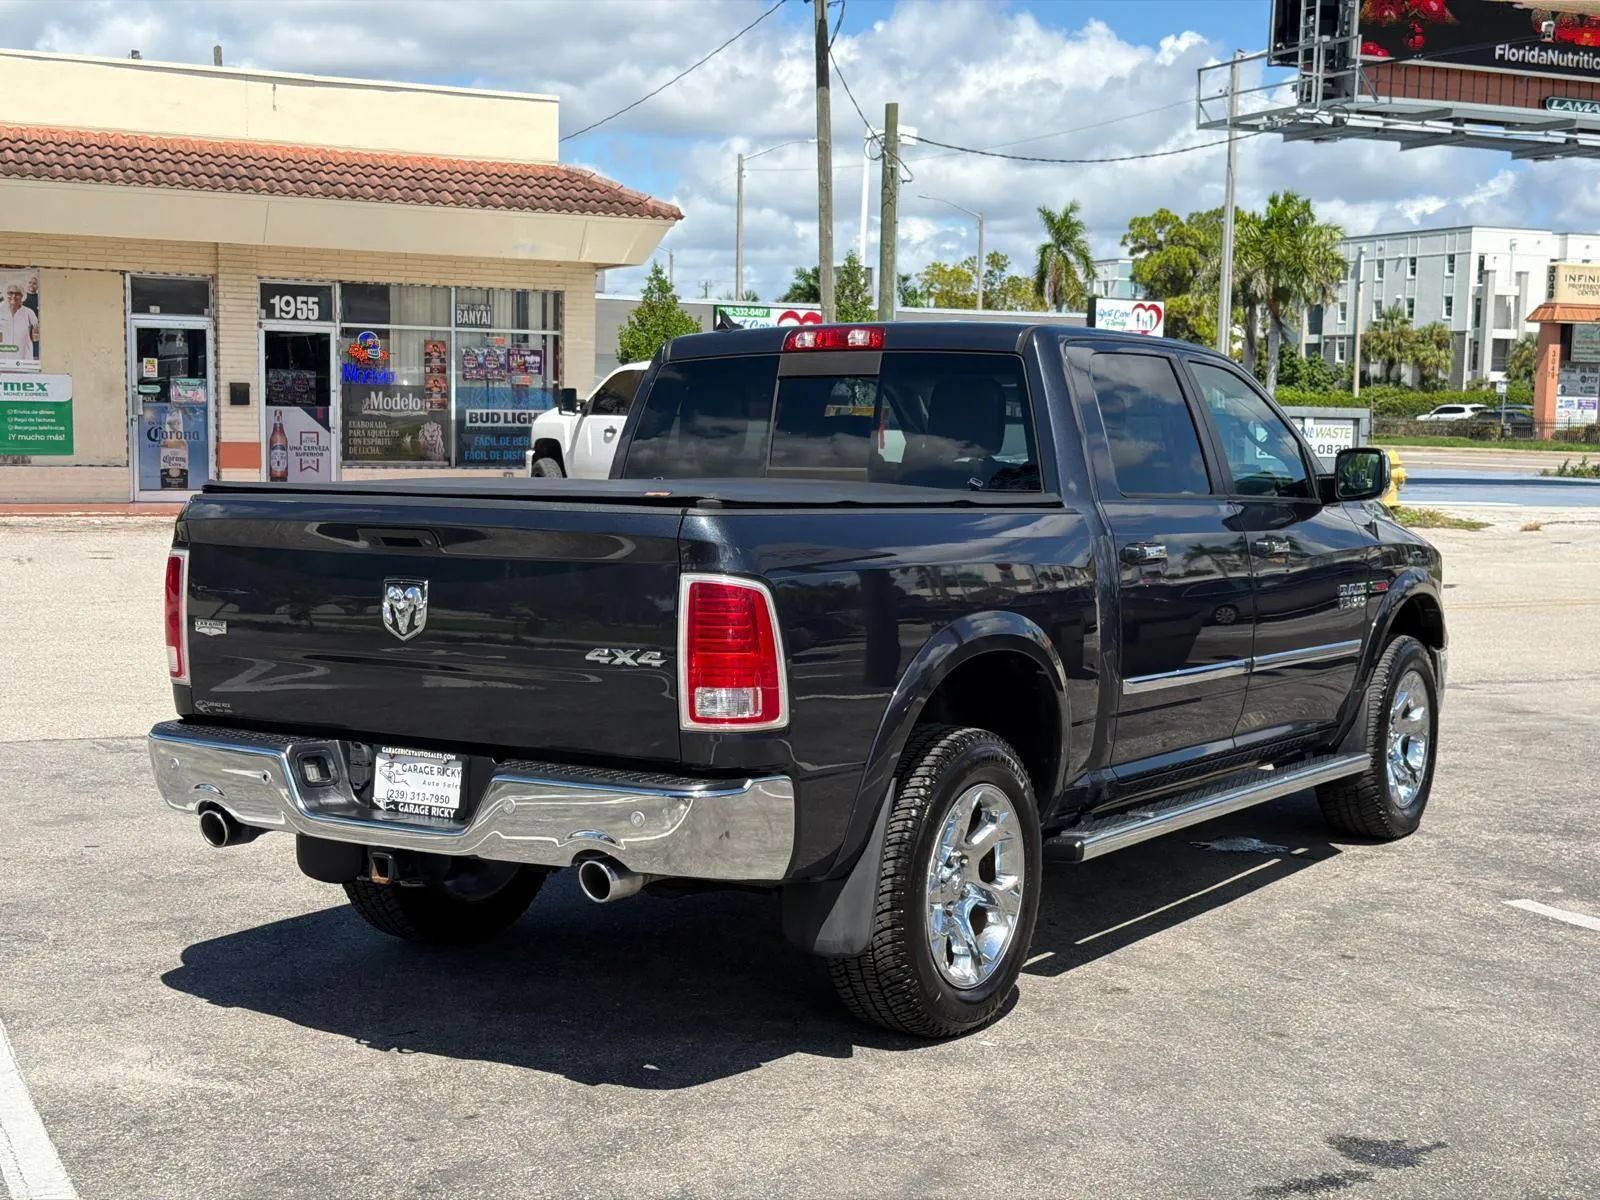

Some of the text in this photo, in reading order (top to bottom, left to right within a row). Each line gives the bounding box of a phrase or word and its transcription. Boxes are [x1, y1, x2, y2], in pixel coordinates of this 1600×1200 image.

[1494, 43, 1600, 70] FloridaNutritio
[269, 295, 319, 321] 1955
[456, 310, 491, 325] BANYAI
[370, 391, 420, 411] Modelo
[468, 411, 542, 424] BUD LIGH
[348, 421, 387, 429] ELABORADA
[17, 433, 46, 441] mucho
[46, 433, 66, 441] más!
[146, 426, 200, 444] Corona
[348, 429, 400, 438] PARA AQUELLOS
[1316, 427, 1351, 439] WASTE
[348, 437, 362, 445] CON
[500, 436, 510, 446] DE
[348, 446, 358, 455] DE
[490, 450, 501, 460] DE
[381, 746, 456, 761] GARAGERICKYAUTOSALES.COM
[401, 763, 462, 779] GARAGE RICKY
[386, 789, 450, 805] (239) 313-7950
[398, 803, 456, 818] GARAGE RICKY
